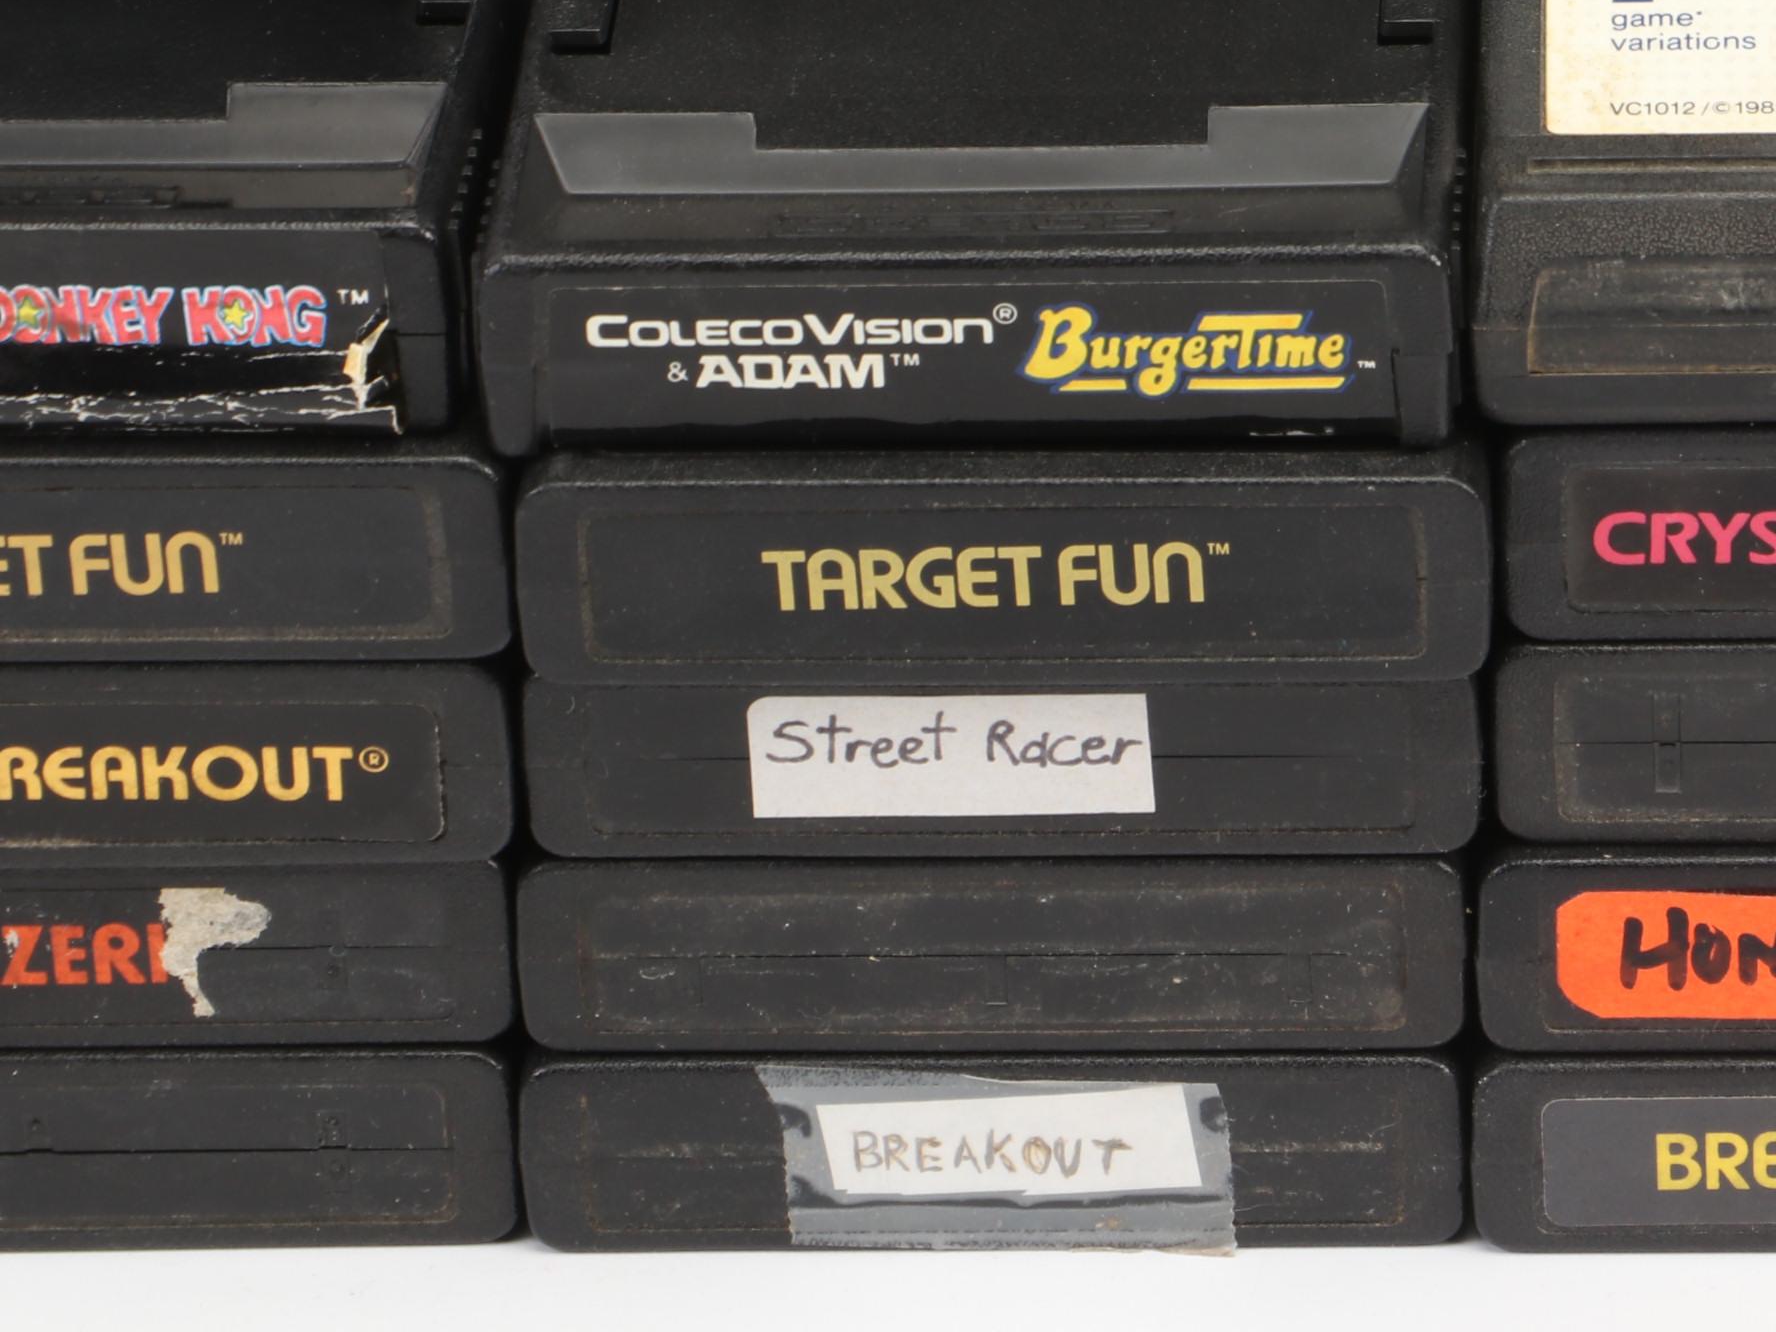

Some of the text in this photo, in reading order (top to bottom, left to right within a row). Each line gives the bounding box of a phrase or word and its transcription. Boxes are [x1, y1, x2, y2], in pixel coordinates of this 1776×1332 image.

[1610, 32, 1757, 51] variations
[666, 361, 689, 384] &
[760, 544, 1043, 612] TARGET
[764, 711, 1144, 767] Street Racer
[850, 1126, 1137, 1177] BREAKOUT
